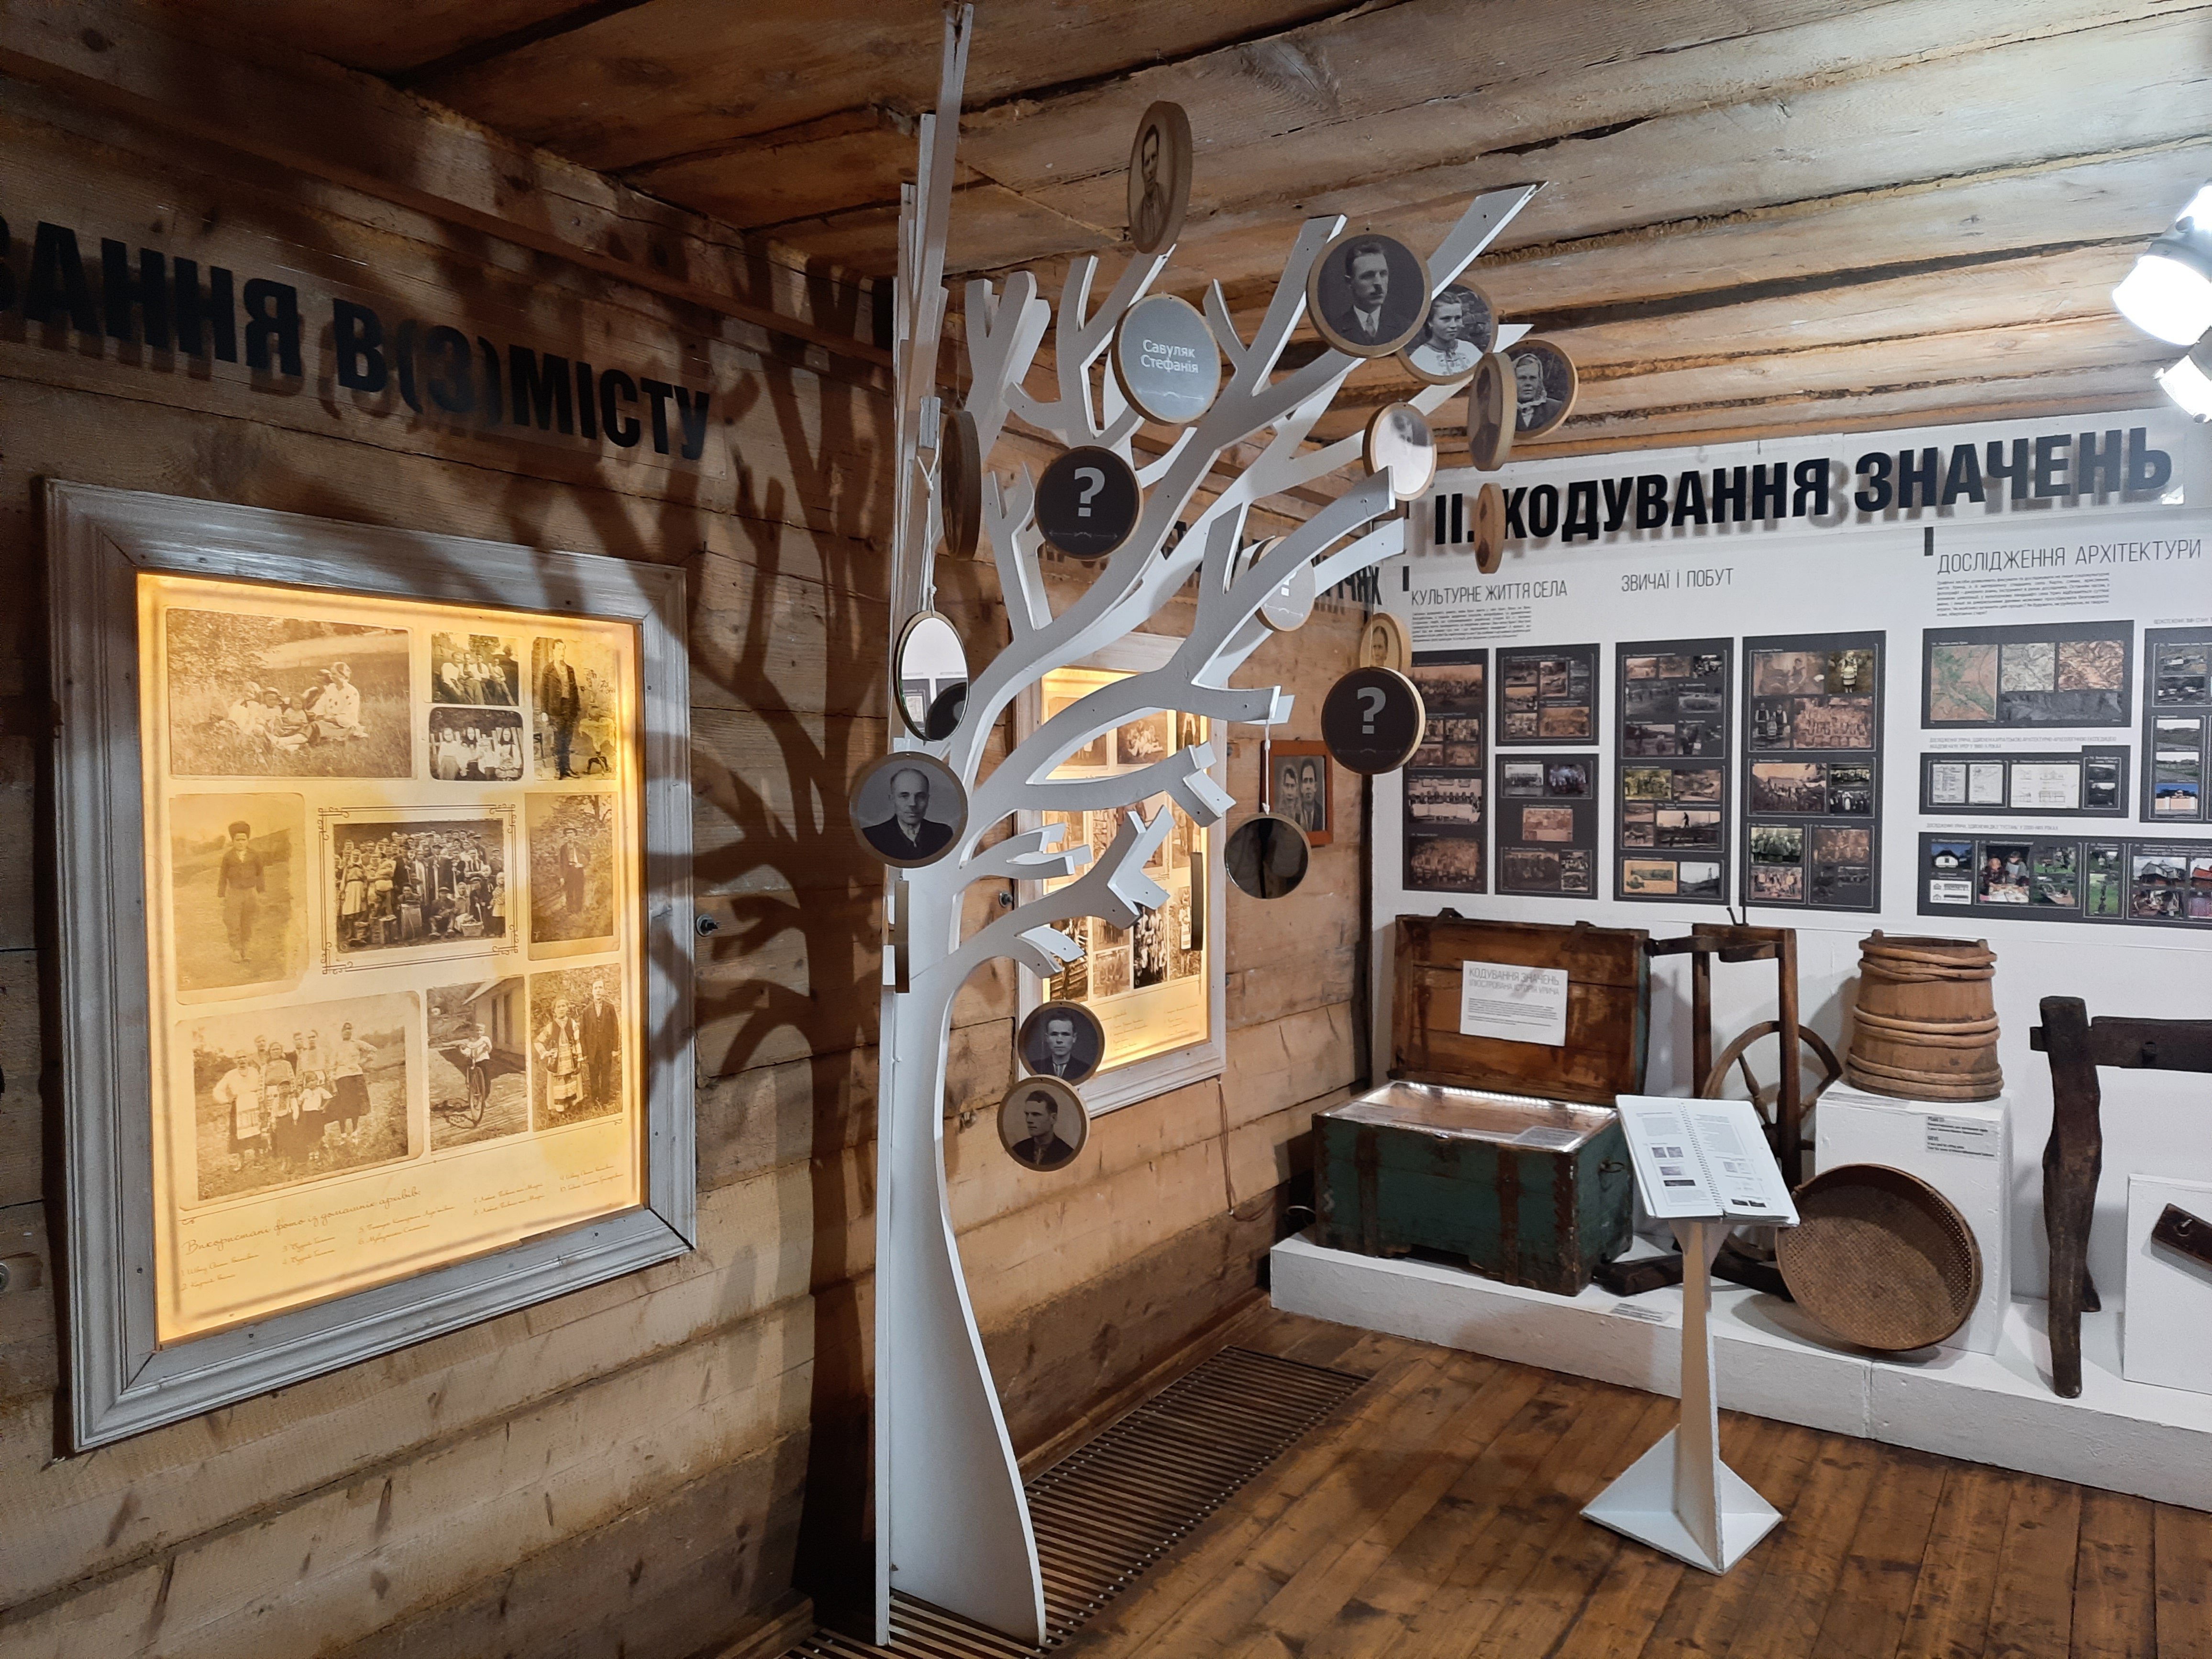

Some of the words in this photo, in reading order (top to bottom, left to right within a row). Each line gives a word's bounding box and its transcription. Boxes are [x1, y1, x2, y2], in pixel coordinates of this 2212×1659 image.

[1142, 339, 1195, 358] Савуляк
[1140, 354, 1199, 373] Стефанія
[1074, 467, 1105, 517] ?
[1503, 458, 1830, 542] КОДУВАННЯ
[1854, 427, 2172, 512] ЗНАЧЕНЬ
[1937, 547, 2065, 575] ДОСЛІДЖЕННЯ
[2075, 539, 2201, 564] АРХІТЕКТУРИ
[1621, 570, 1670, 592] ЗВИЧАЇ
[1687, 568, 1734, 587] ПОБУТ
[1412, 585, 1482, 606] КУЛЬТУРНЕ
[1485, 582, 1530, 601] ЖИТТЯ
[1533, 580, 1568, 598] СЕЛА
[1357, 686, 1386, 734] ?
[1469, 968, 1520, 982] КОДУВАННЯ
[274, 1219, 305, 1236] фото
